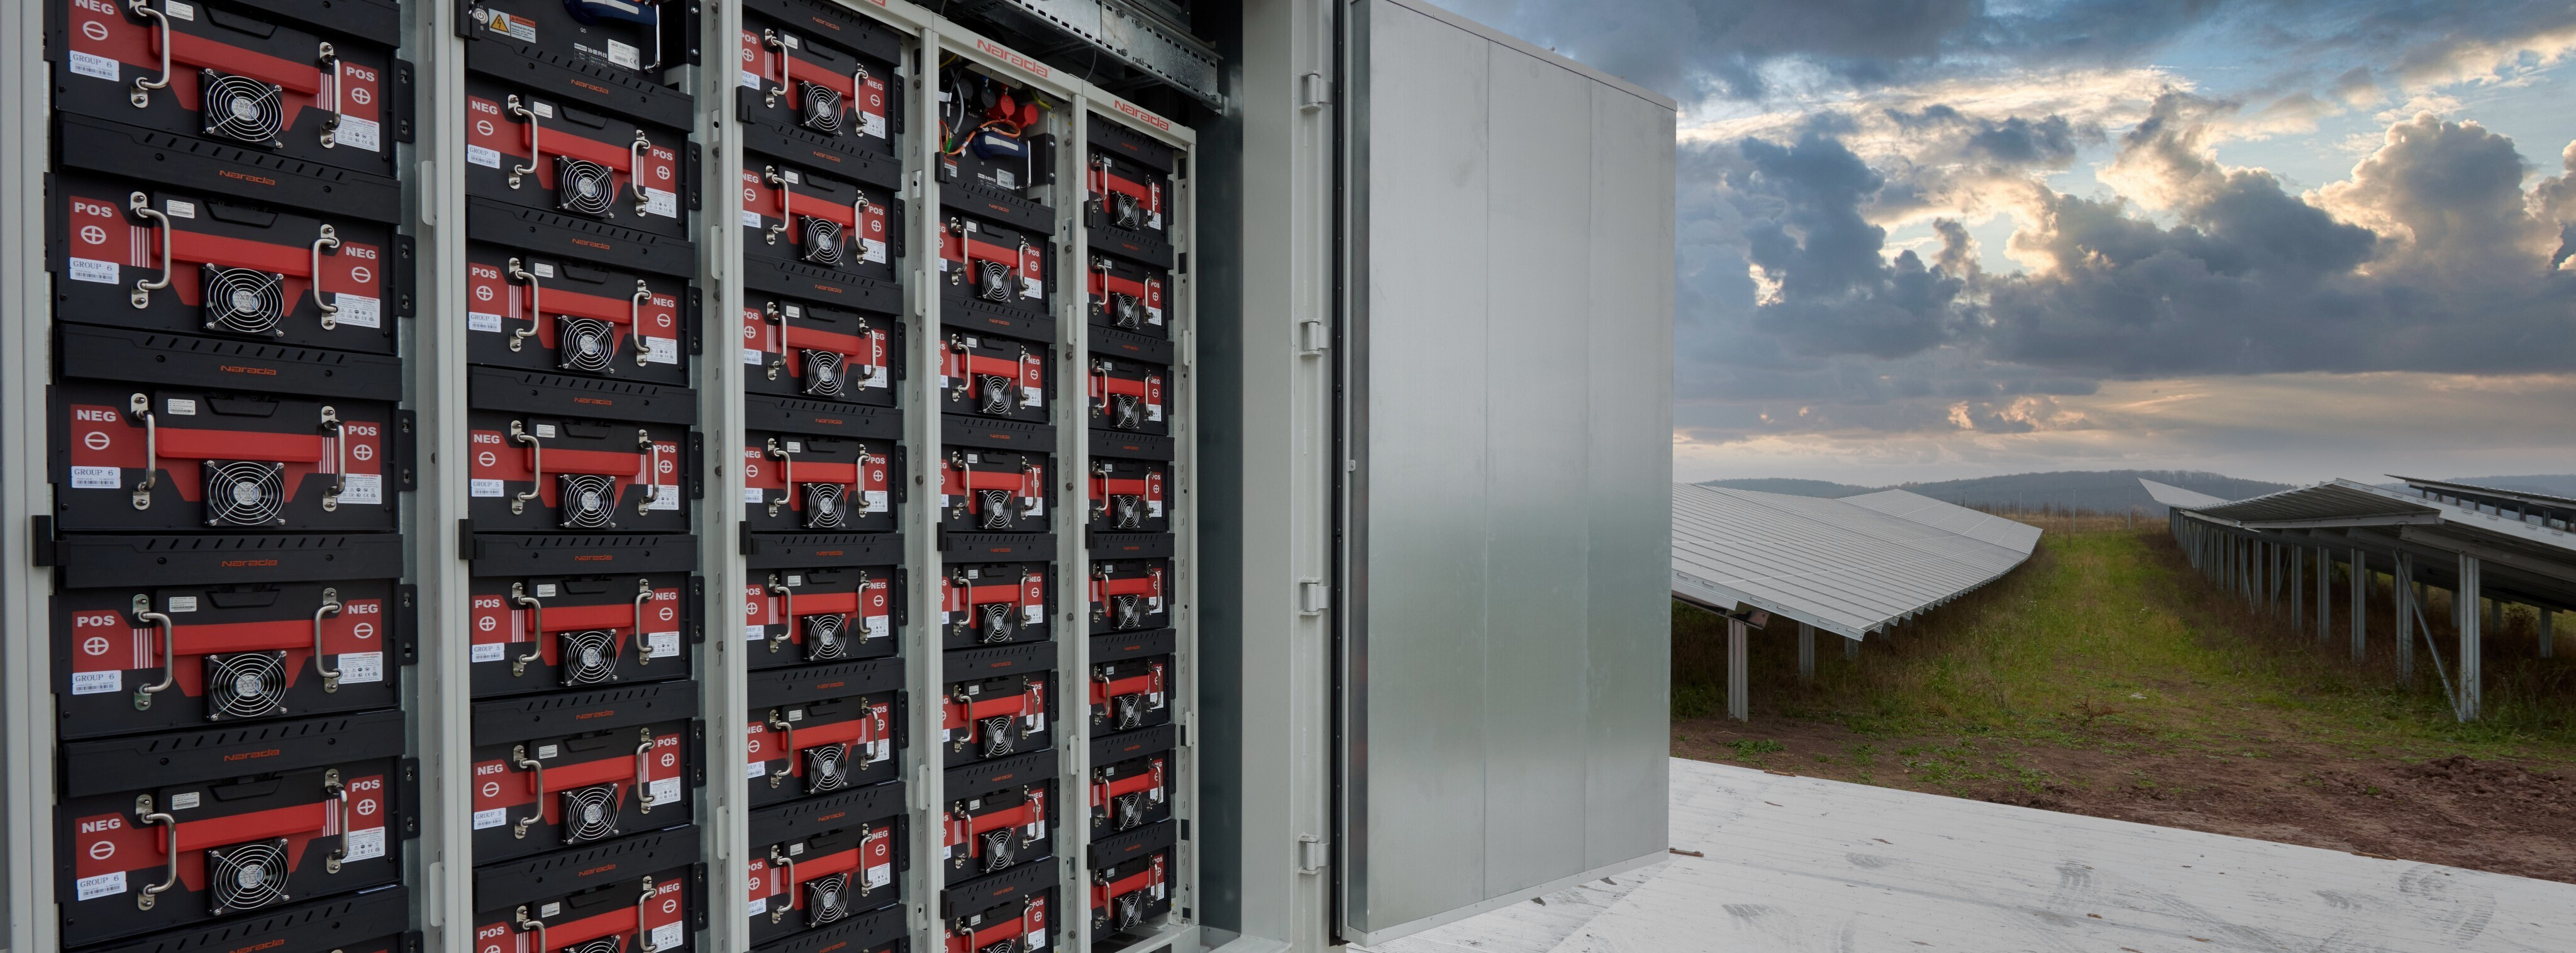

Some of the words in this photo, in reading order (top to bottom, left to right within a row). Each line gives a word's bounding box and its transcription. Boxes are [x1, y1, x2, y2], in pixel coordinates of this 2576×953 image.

[75, 0, 114, 15] NEG
[516, 17, 535, 26] WARNING
[73, 54, 101, 65] GROUP
[347, 67, 374, 81] POS
[571, 79, 609, 94] Narada
[868, 79, 882, 90] NEG
[472, 101, 497, 114] NEG
[469, 147, 489, 155] GROUP
[653, 149, 672, 160] POS
[219, 170, 275, 186] Narada
[75, 203, 112, 217] POS
[869, 206, 883, 215] POS
[572, 238, 610, 250] Narada
[347, 247, 375, 259] NEG
[1028, 248, 1040, 257] POS
[73, 260, 101, 269] GROUP
[472, 267, 497, 279] POS
[653, 298, 674, 307] NEG
[221, 365, 277, 376] Narada
[77, 410, 116, 421] NEG
[348, 426, 377, 435] POS
[474, 434, 499, 443] NEG
[475, 599, 499, 608] POS
[348, 605, 378, 614] NEG
[77, 616, 114, 627] POS
[75, 674, 103, 682] GROUP
[576, 711, 614, 720] Narada
[658, 737, 677, 747] POS
[224, 749, 280, 761] Narada
[478, 764, 503, 775] NEG
[352, 780, 380, 792] POS
[82, 818, 120, 833] NEG
[873, 830, 888, 840] NEG
[579, 864, 616, 876] Narada
[80, 877, 108, 888] GROUP
[659, 883, 679, 894] NEG
[1032, 899, 1043, 907] POS
[480, 927, 504, 939] POS
